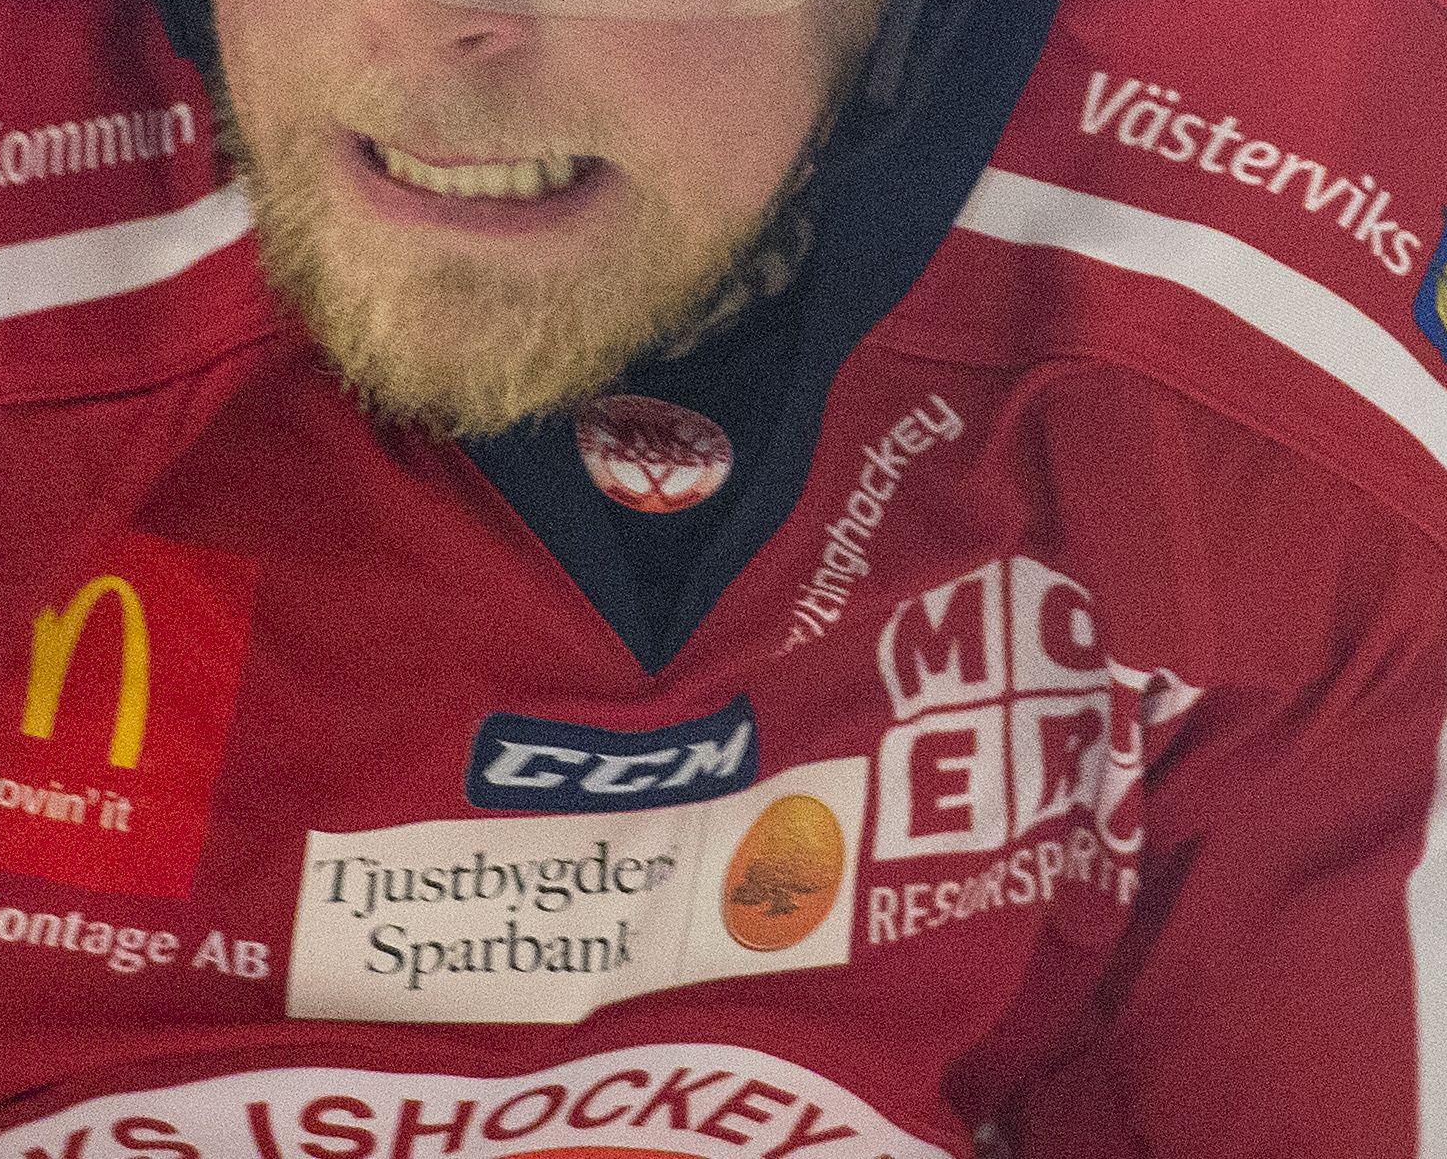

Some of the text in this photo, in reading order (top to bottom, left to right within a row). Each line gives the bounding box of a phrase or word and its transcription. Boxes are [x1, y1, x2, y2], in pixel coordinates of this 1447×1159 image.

[1079, 70, 1423, 275] Västerviks
[483, 720, 752, 795] CCM
[190, 929, 270, 981] AB
[246, 1067, 859, 1158] ISHOCKEY
